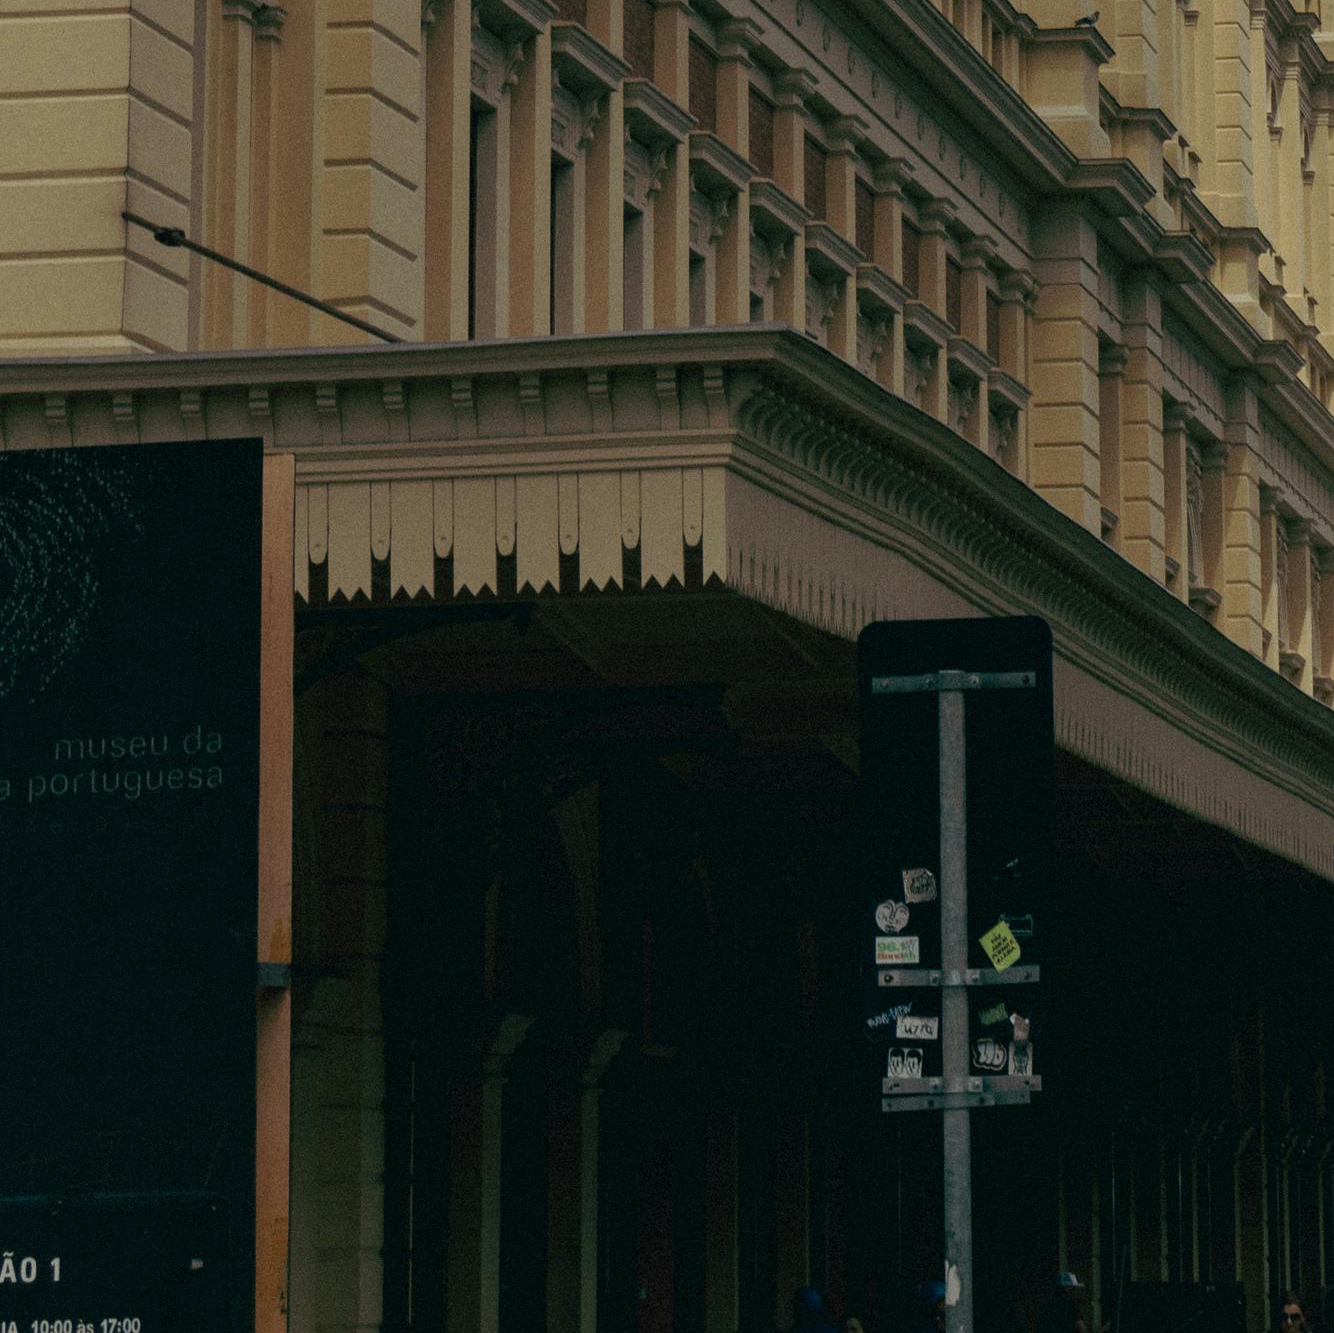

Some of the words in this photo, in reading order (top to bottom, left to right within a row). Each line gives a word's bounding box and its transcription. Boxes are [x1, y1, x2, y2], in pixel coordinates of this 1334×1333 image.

[54, 735, 169, 761] museu
[182, 724, 223, 755] da
[27, 765, 223, 804] portuguesa
[51, 1257, 61, 1282] 1
[31, 1319, 73, 1333] 10:00
[76, 1319, 95, 1333] às
[100, 1317, 142, 1333] 17:00
